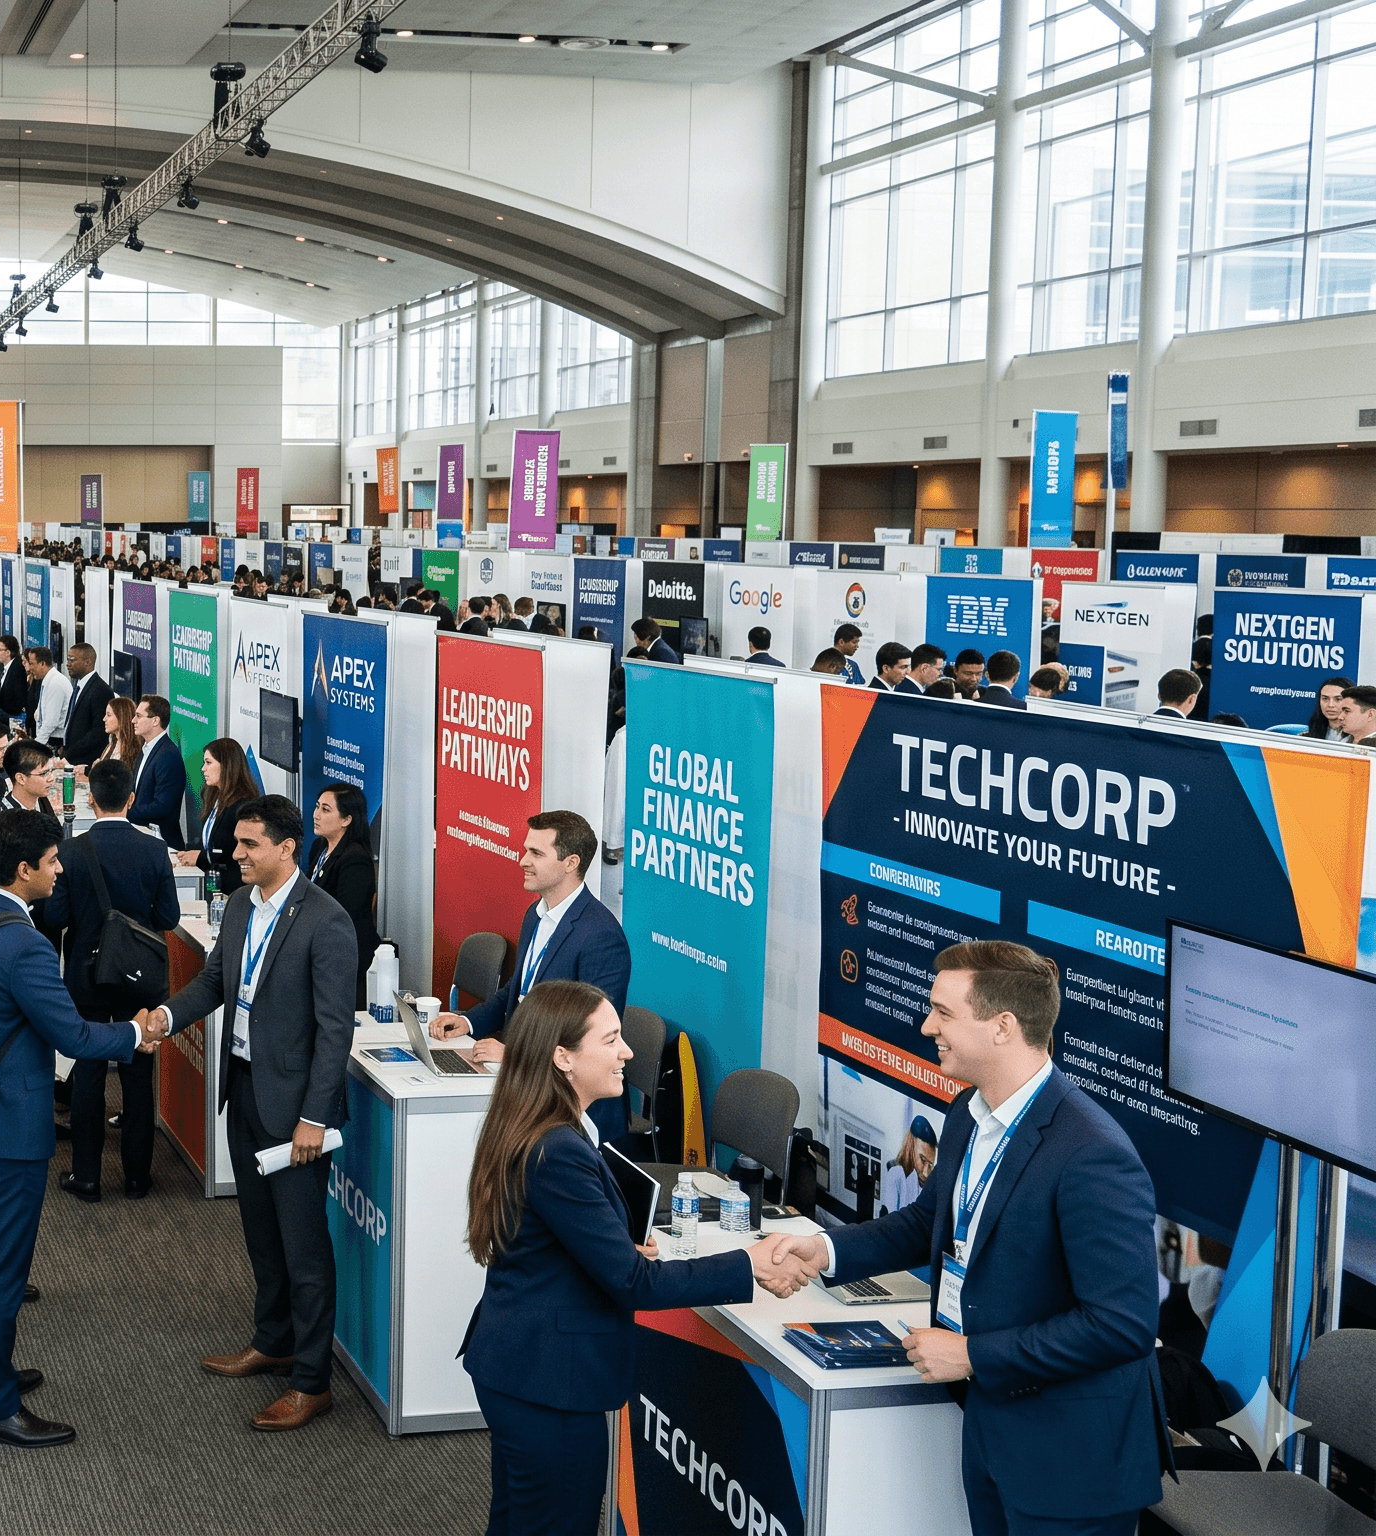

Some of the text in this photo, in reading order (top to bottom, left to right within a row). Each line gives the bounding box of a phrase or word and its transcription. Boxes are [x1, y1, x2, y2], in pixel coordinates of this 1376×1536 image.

[648, 577, 697, 601] Deloitte.
[729, 580, 783, 615] Google
[946, 594, 1009, 637] IBM
[1074, 609, 1150, 627] NEXTGEN
[1234, 612, 1335, 642] NEXTGEN
[247, 641, 281, 673] APEX
[330, 655, 376, 691] APEX
[1224, 638, 1345, 671] SOLUTIONS
[330, 687, 375, 714] SYSTEMS
[442, 686, 533, 741] LEADERSHIP
[441, 727, 531, 791] PATHWAYS
[648, 743, 740, 805] GLOBAL
[892, 732, 1176, 846] TECHCORP
[642, 787, 745, 855] FINANCE
[630, 829, 755, 907] PARTNERS
[904, 808, 999, 855] INNOVATE
[1003, 832, 1062, 871] YOUR
[1068, 847, 1161, 896] FUTURE
[327, 1160, 387, 1247] CHCORP
